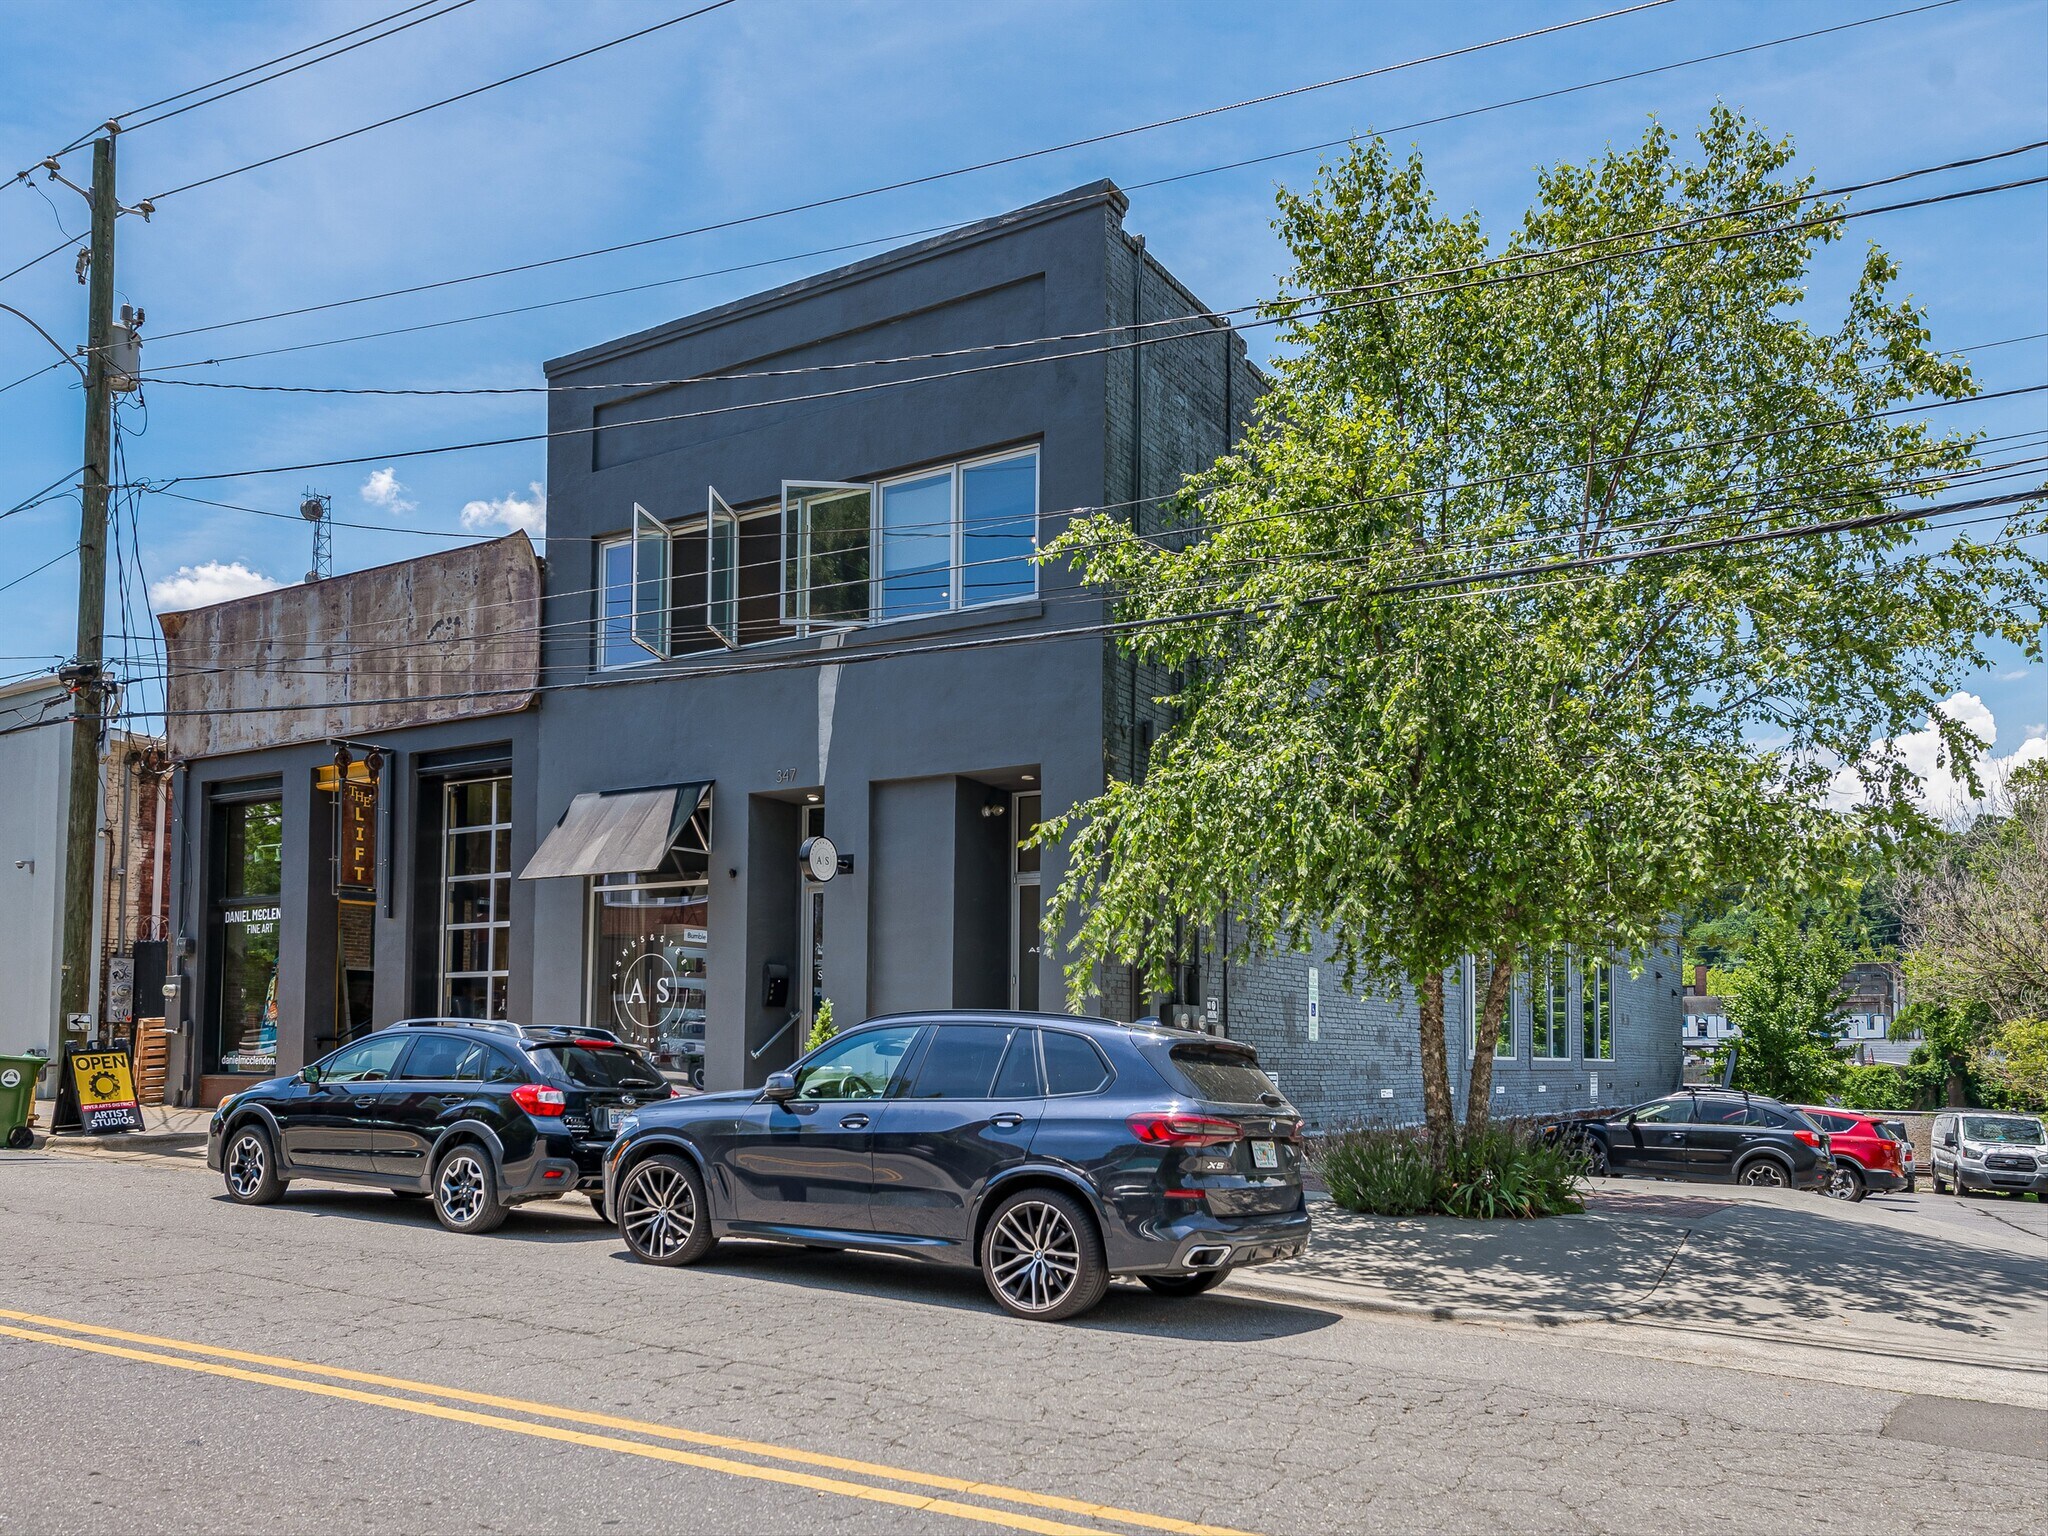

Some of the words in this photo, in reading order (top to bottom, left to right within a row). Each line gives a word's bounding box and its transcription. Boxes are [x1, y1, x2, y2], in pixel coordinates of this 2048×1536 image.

[776, 767, 797, 783] 347
[349, 785, 372, 808] THE
[354, 807, 365, 881] LIFT
[225, 910, 251, 923] DANIEL
[246, 923, 261, 934] FINE
[261, 922, 274, 933] ART
[687, 931, 707, 941] Bumble
[75, 1055, 126, 1071] OPEN
[94, 1109, 128, 1119] ARTIST
[91, 1116, 135, 1128] STUDIOS
[1207, 1161, 1225, 1170] X5
